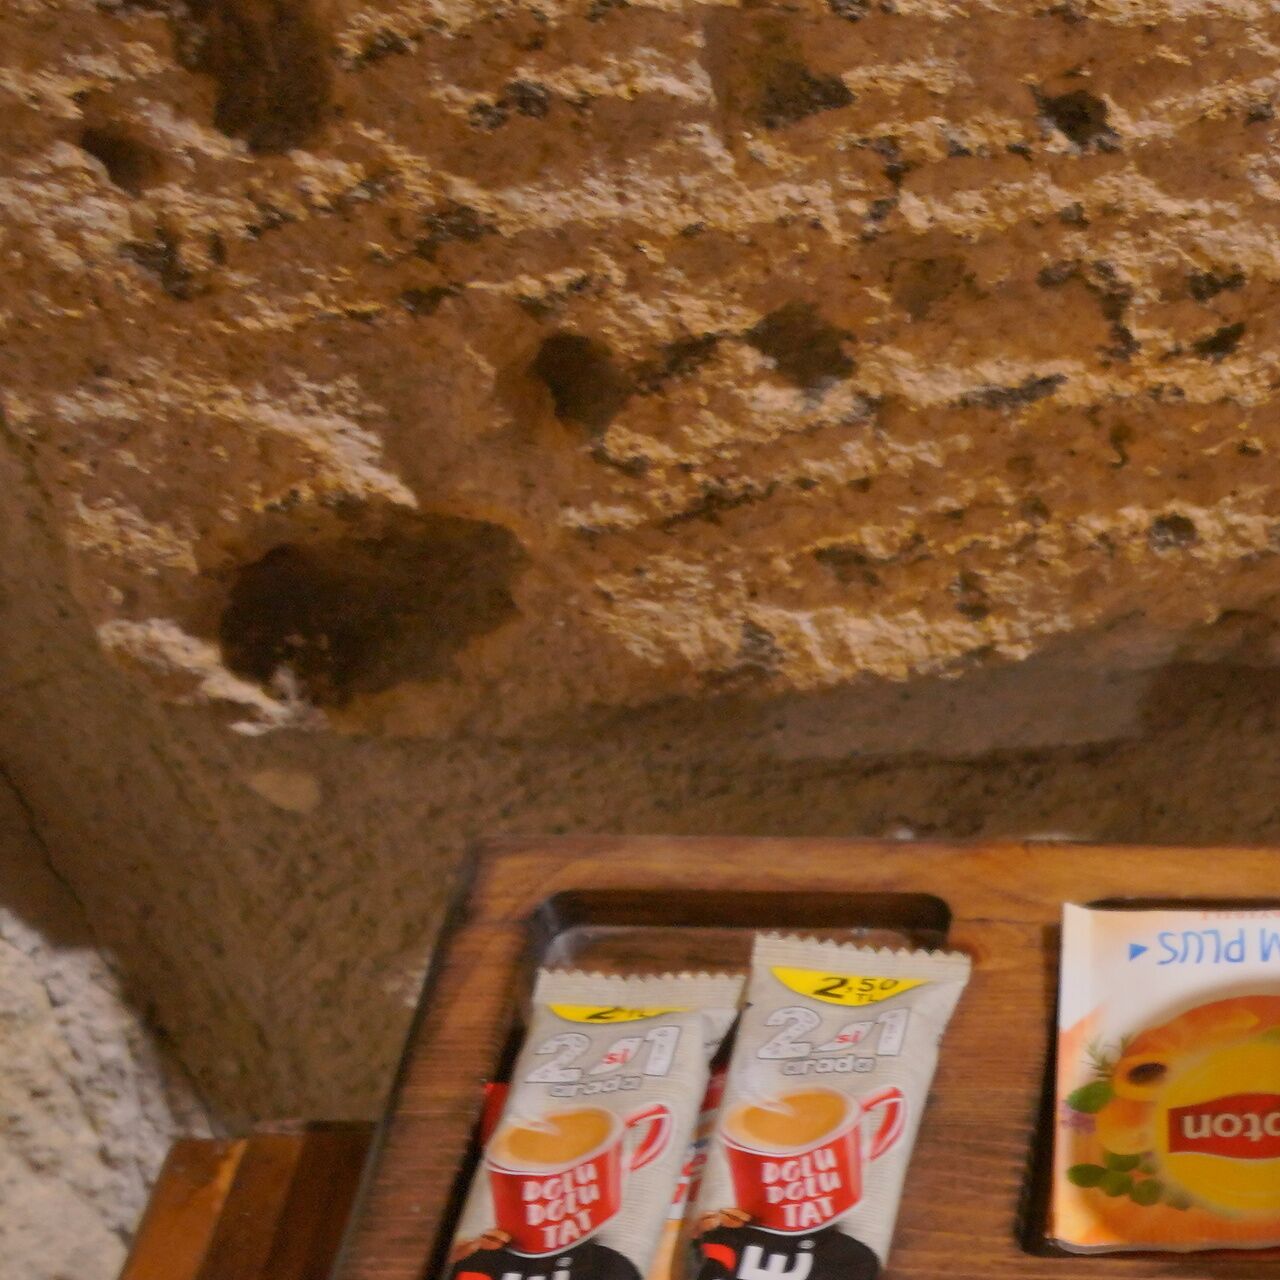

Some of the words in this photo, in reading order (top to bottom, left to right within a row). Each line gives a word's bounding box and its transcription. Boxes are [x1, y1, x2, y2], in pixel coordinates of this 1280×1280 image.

[1156, 928, 1247, 966] PLUS
[783, 1054, 876, 1076] arada
[550, 1075, 644, 1098] arada
[523, 1162, 599, 1203] DOLU
[761, 1148, 838, 1185] DOLU
[525, 1183, 600, 1227] DOLU
[765, 1171, 844, 1205] DOLU
[541, 1208, 594, 1250] TAT
[780, 1197, 836, 1230] TAT
